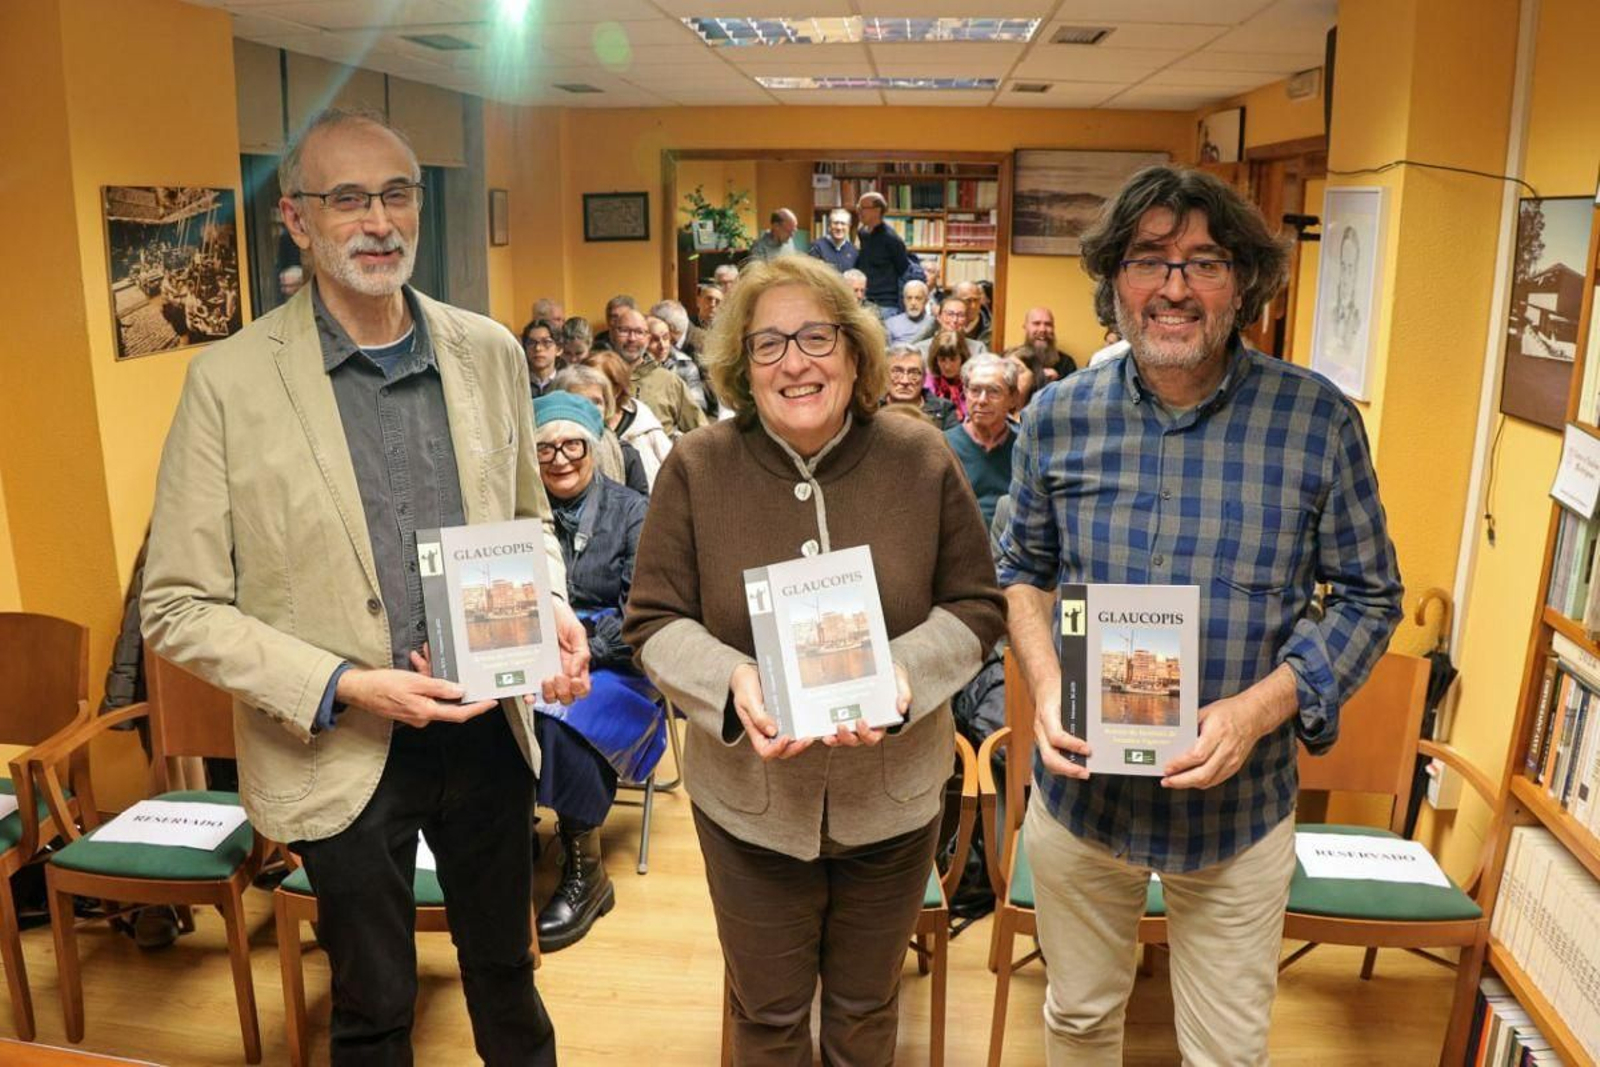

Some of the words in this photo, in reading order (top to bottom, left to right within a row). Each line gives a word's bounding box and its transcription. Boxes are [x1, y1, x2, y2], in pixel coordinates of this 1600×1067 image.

[453, 542, 534, 561] GLAUCOPIS
[781, 570, 863, 597] GLAUCOPIS
[1098, 611, 1184, 625] GLAUCOPIS
[132, 815, 224, 827] RESERVADO
[1314, 848, 1417, 862] RESERVADO
